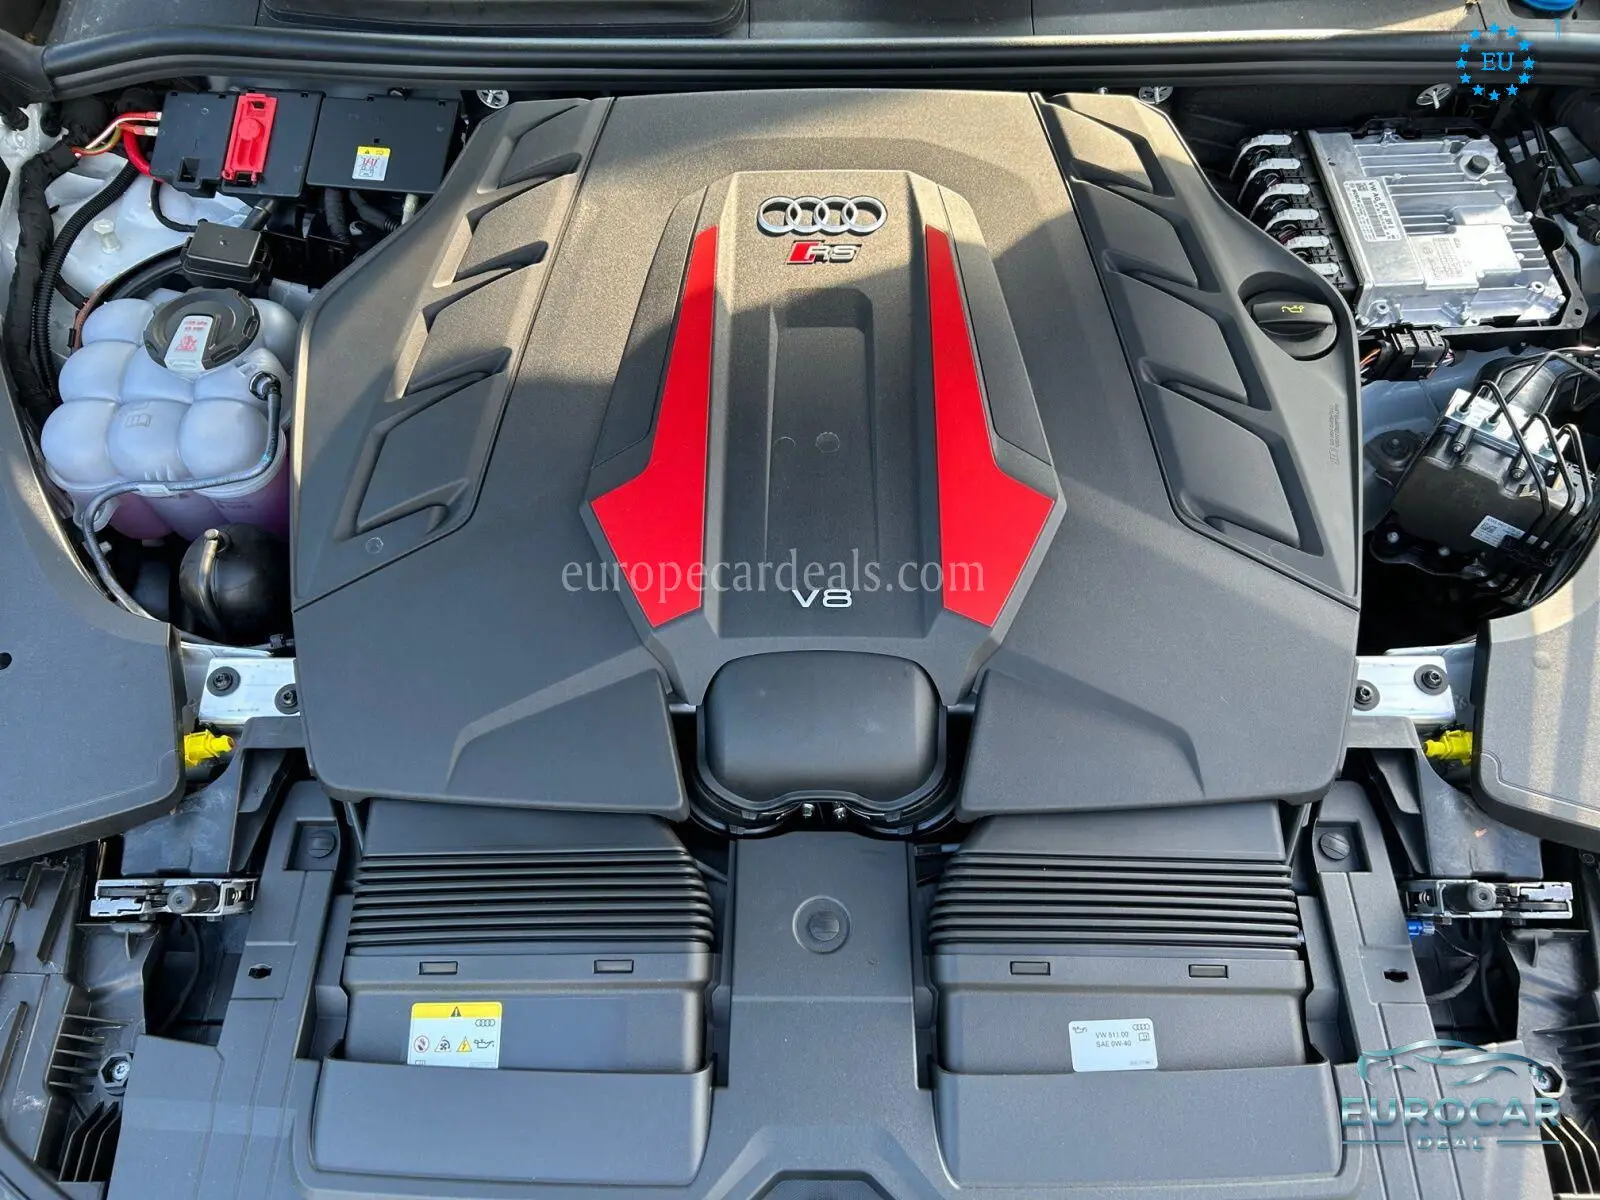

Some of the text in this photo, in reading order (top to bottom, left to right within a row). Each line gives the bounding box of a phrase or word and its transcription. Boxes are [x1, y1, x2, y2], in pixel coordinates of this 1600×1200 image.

[788, 241, 861, 263] RS
[791, 589, 853, 608] V8
[1095, 1031, 1107, 1039] VW
[1096, 1040, 1110, 1048] SAE
